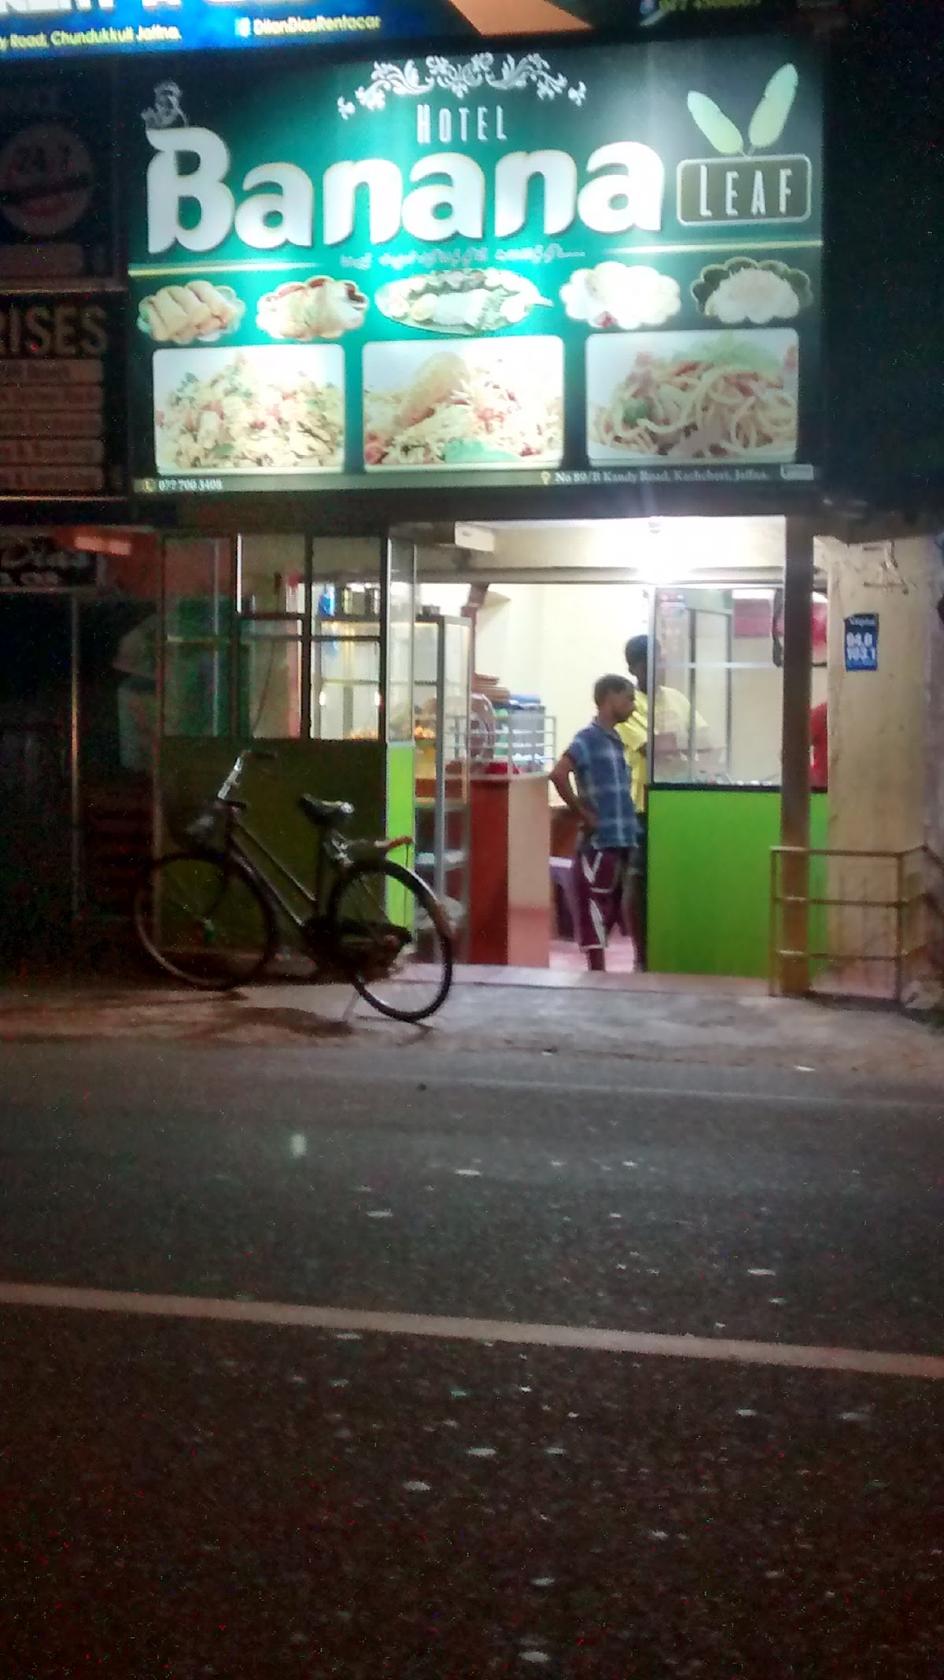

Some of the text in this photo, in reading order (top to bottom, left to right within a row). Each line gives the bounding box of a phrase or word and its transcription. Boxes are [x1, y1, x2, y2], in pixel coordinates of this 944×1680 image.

[416, 103, 507, 145] HOTEL
[145, 127, 665, 254] Banana
[699, 165, 792, 217] LEAF
